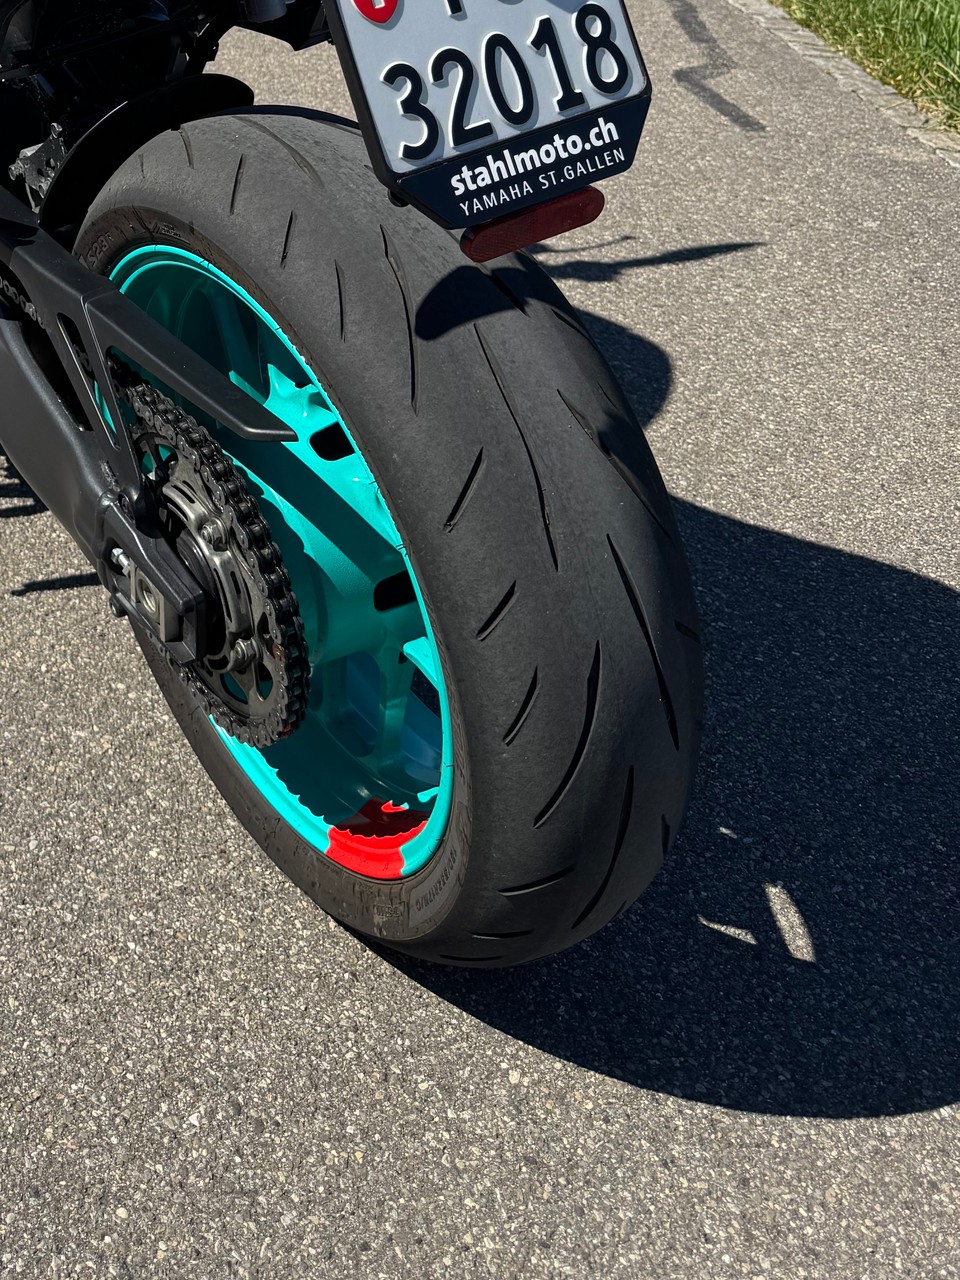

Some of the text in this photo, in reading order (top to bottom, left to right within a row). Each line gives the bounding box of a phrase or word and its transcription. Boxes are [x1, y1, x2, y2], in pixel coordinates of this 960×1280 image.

[381, 2, 632, 162] 32018
[450, 118, 620, 197] stahlmoto.ch
[458, 146, 626, 218] YAMAHA ST.GALLEN
